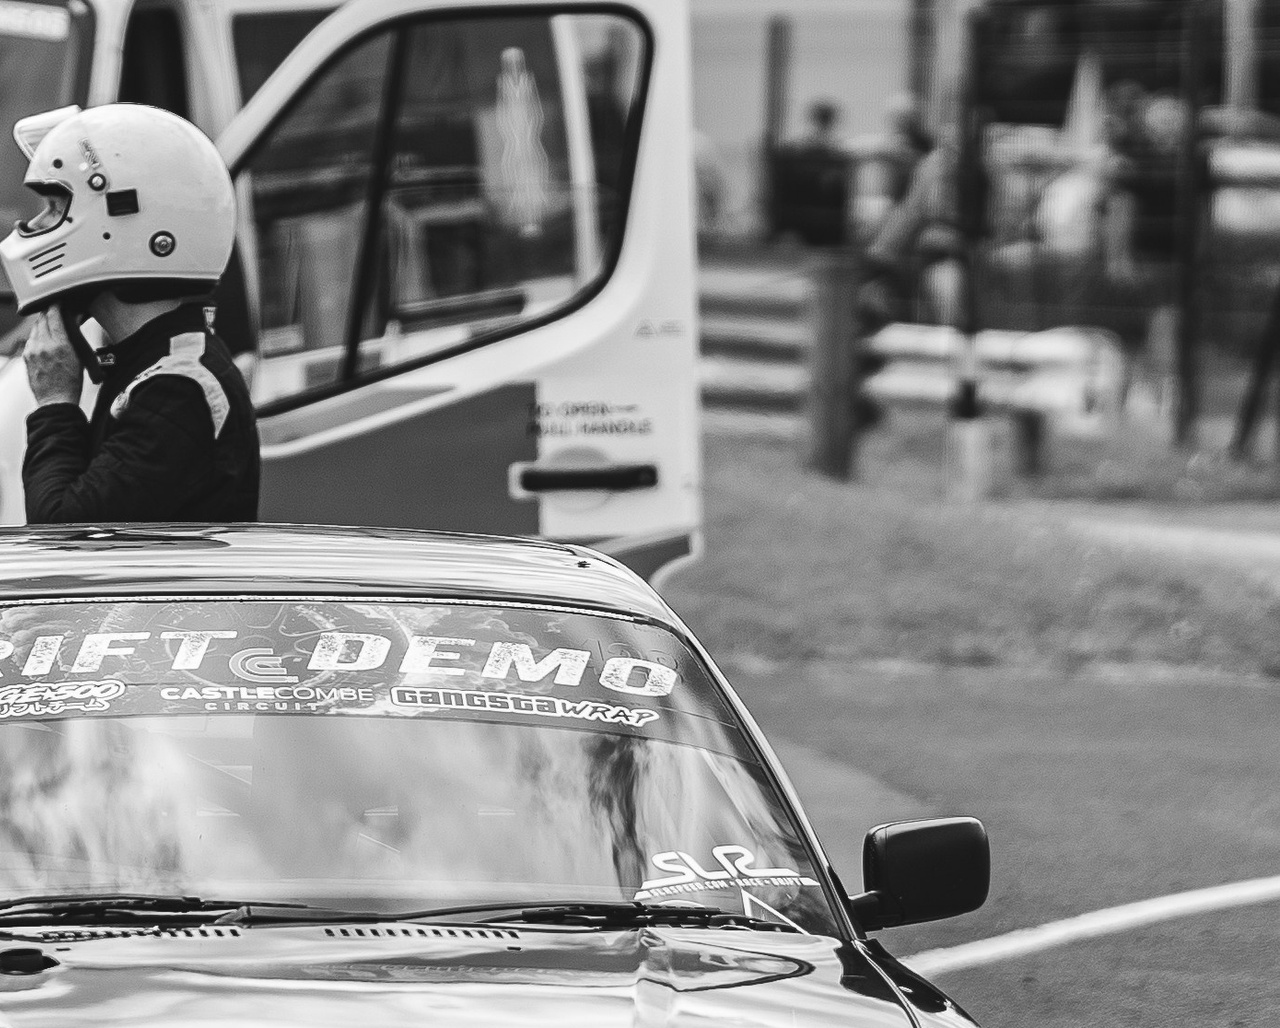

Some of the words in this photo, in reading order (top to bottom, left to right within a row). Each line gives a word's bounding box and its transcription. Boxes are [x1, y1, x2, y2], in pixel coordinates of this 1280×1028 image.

[306, 632, 678, 697] DEMO
[204, 702, 319, 711] CIRCUIT
[640, 844, 800, 890] SLR
